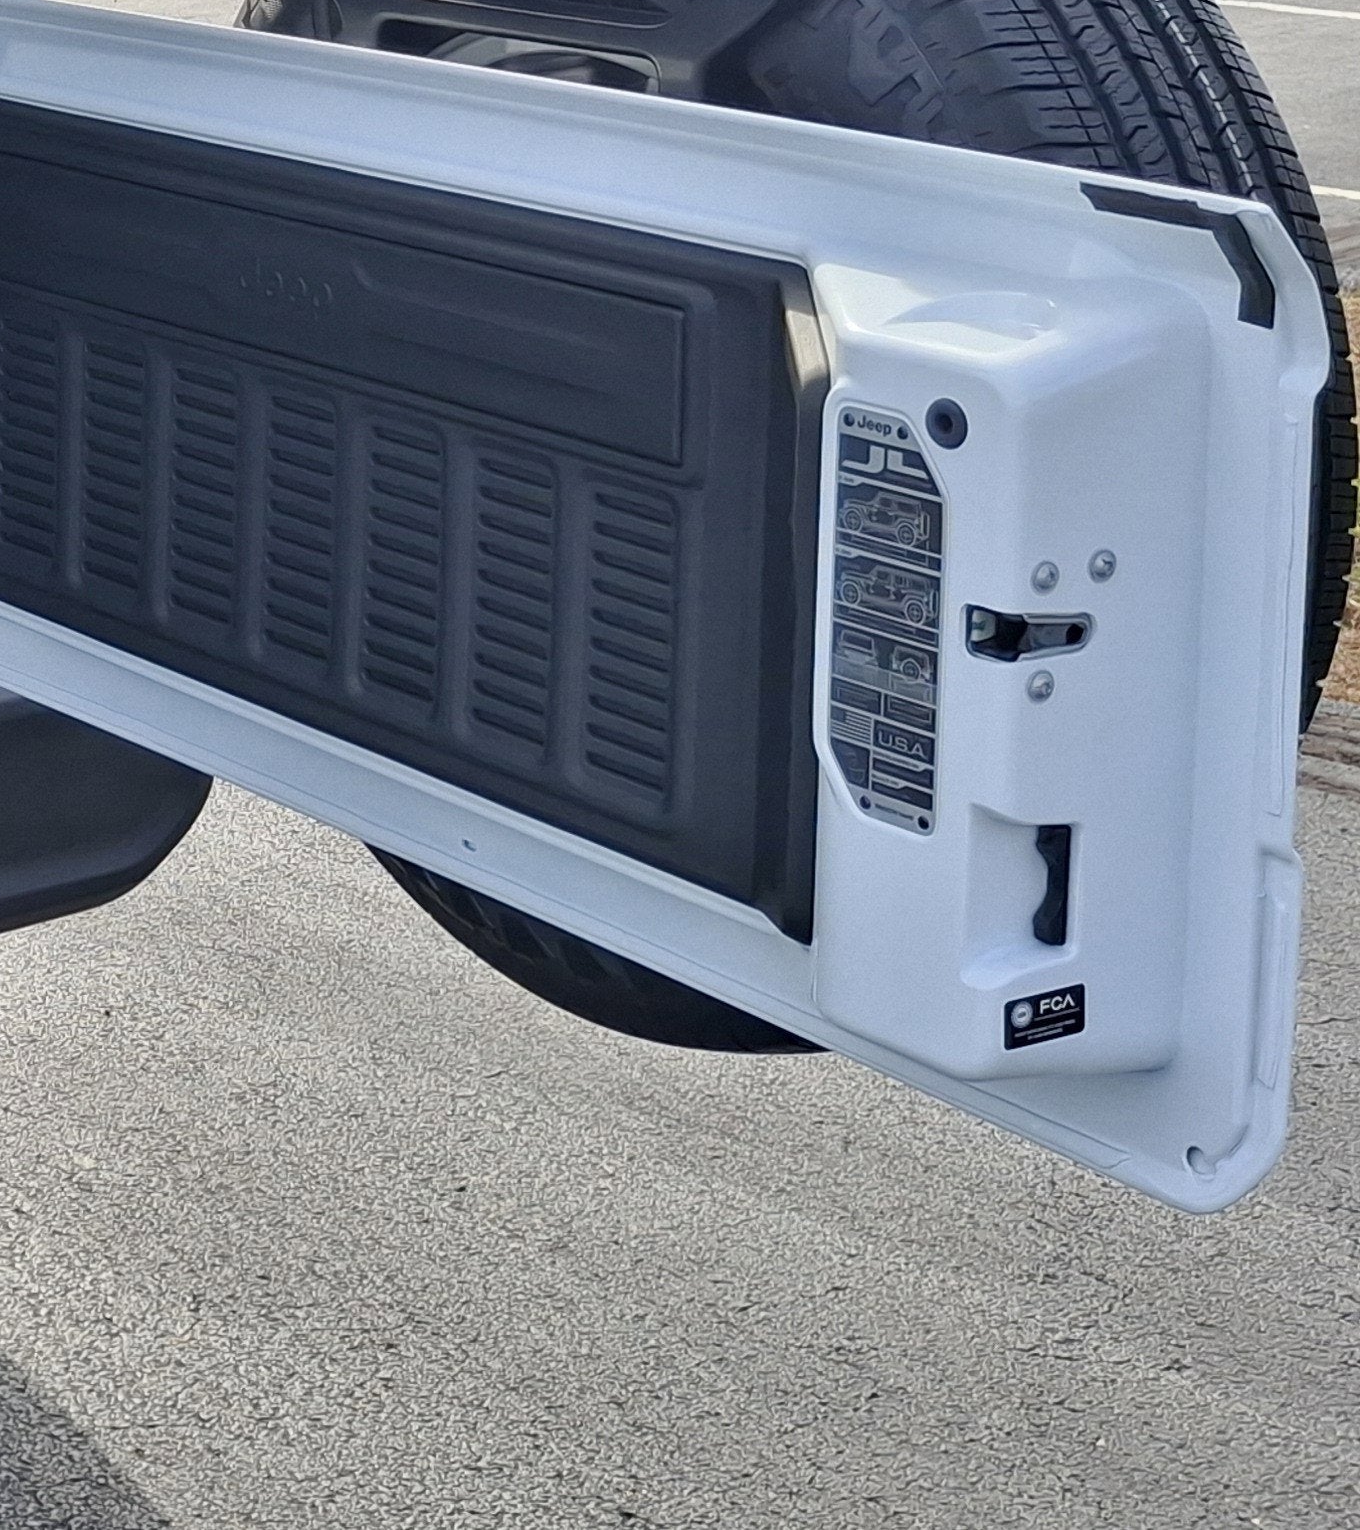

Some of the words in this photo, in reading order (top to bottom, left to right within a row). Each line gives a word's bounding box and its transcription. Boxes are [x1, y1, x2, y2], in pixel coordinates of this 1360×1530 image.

[857, 414, 892, 437] Jeep
[841, 444, 929, 481] JL
[1039, 993, 1076, 1015] FCA
